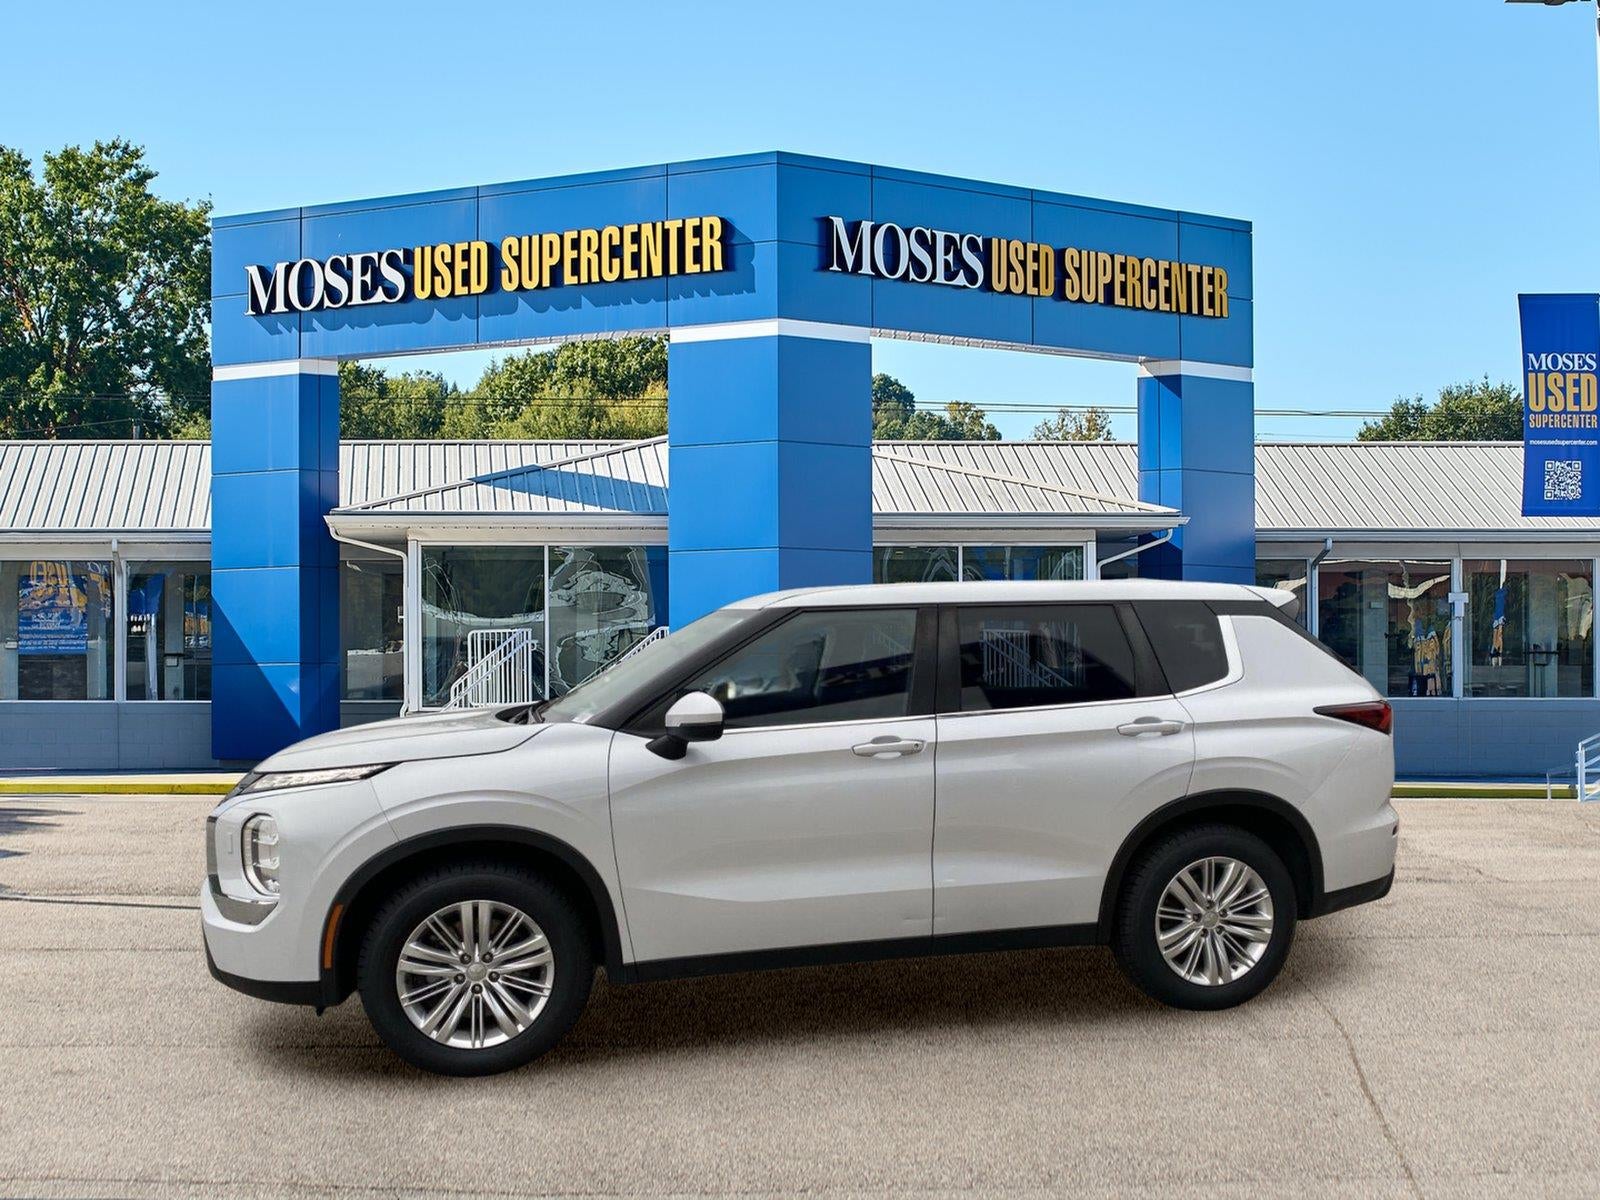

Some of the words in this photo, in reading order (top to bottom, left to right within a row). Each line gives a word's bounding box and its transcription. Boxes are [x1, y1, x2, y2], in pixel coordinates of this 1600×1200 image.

[245, 249, 406, 315] MOSES
[413, 241, 487, 300] USED
[501, 216, 724, 291] SUPERCENTER
[829, 216, 985, 288] MOSES
[991, 238, 1055, 297] USED
[1065, 247, 1229, 318] SUPERCENTER
[1527, 352, 1597, 371] MOSES
[1528, 372, 1598, 412] USED
[1529, 413, 1598, 428] SUPERCENTER
